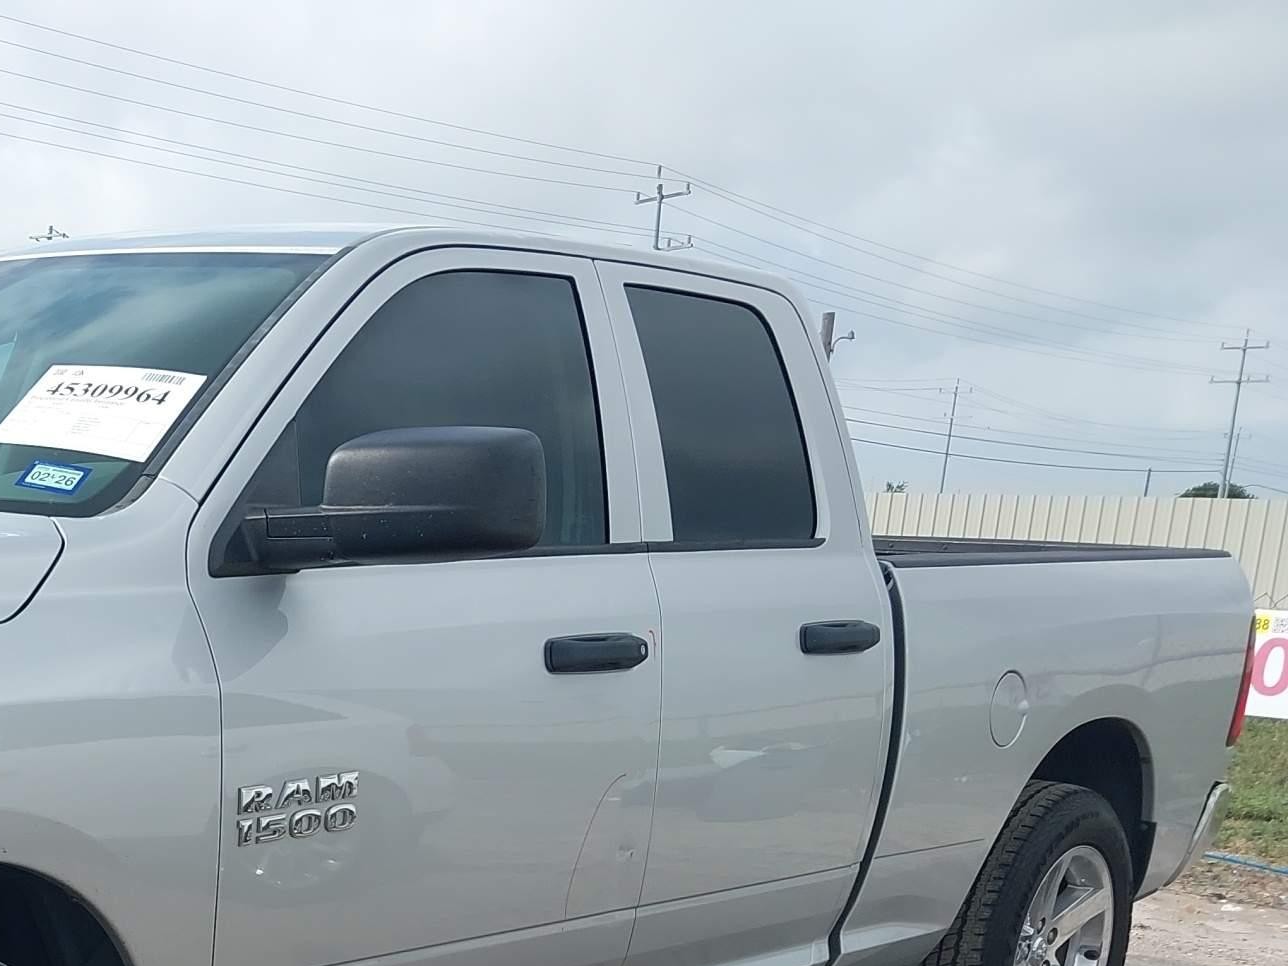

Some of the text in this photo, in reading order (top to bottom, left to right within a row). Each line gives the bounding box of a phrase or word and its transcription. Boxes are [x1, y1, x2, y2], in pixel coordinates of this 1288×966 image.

[46, 381, 172, 405] 45309964
[31, 471, 50, 481] 02
[54, 474, 76, 486] 26
[237, 770, 360, 815] RAM
[236, 802, 358, 847] 1500
